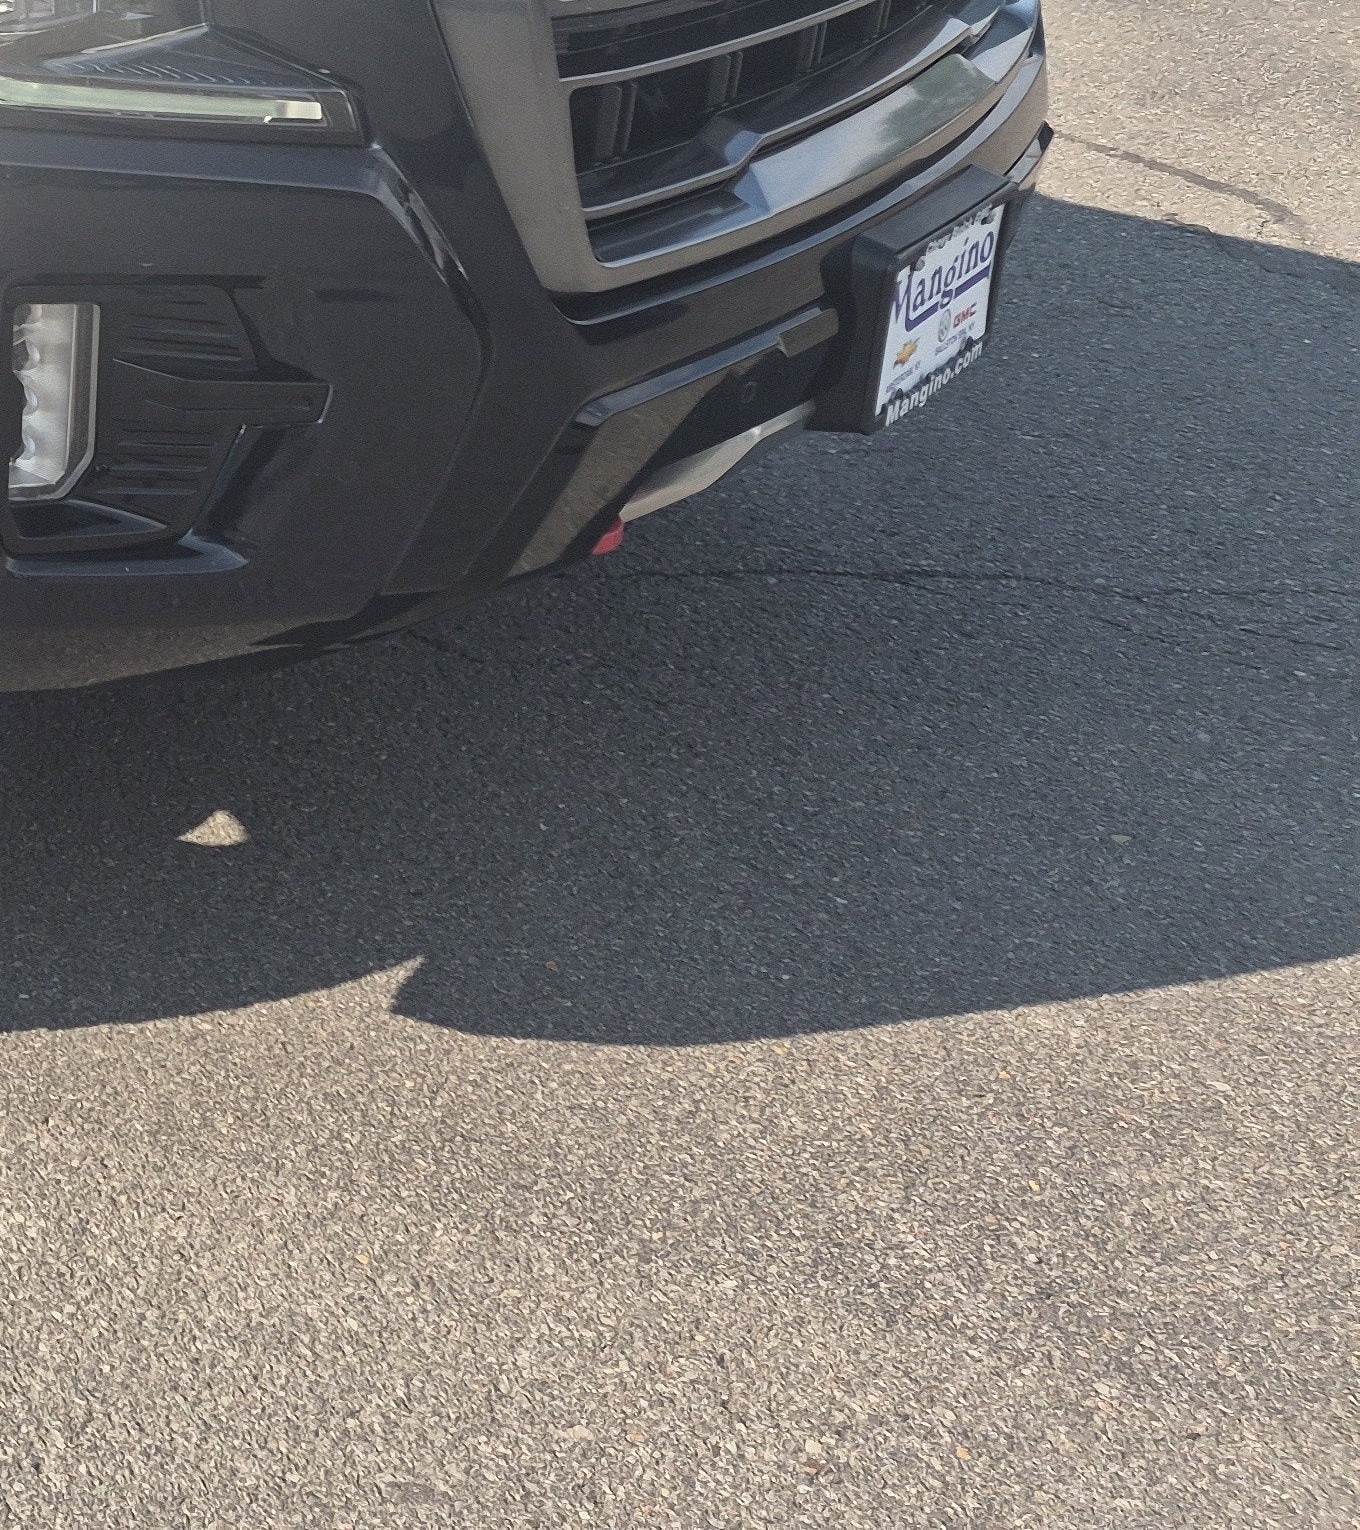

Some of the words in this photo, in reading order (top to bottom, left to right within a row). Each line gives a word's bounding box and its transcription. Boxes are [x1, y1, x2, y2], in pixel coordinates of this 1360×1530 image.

[893, 231, 995, 331] Mangino
[952, 302, 978, 329] GMC
[885, 341, 983, 427] Mangino.com
